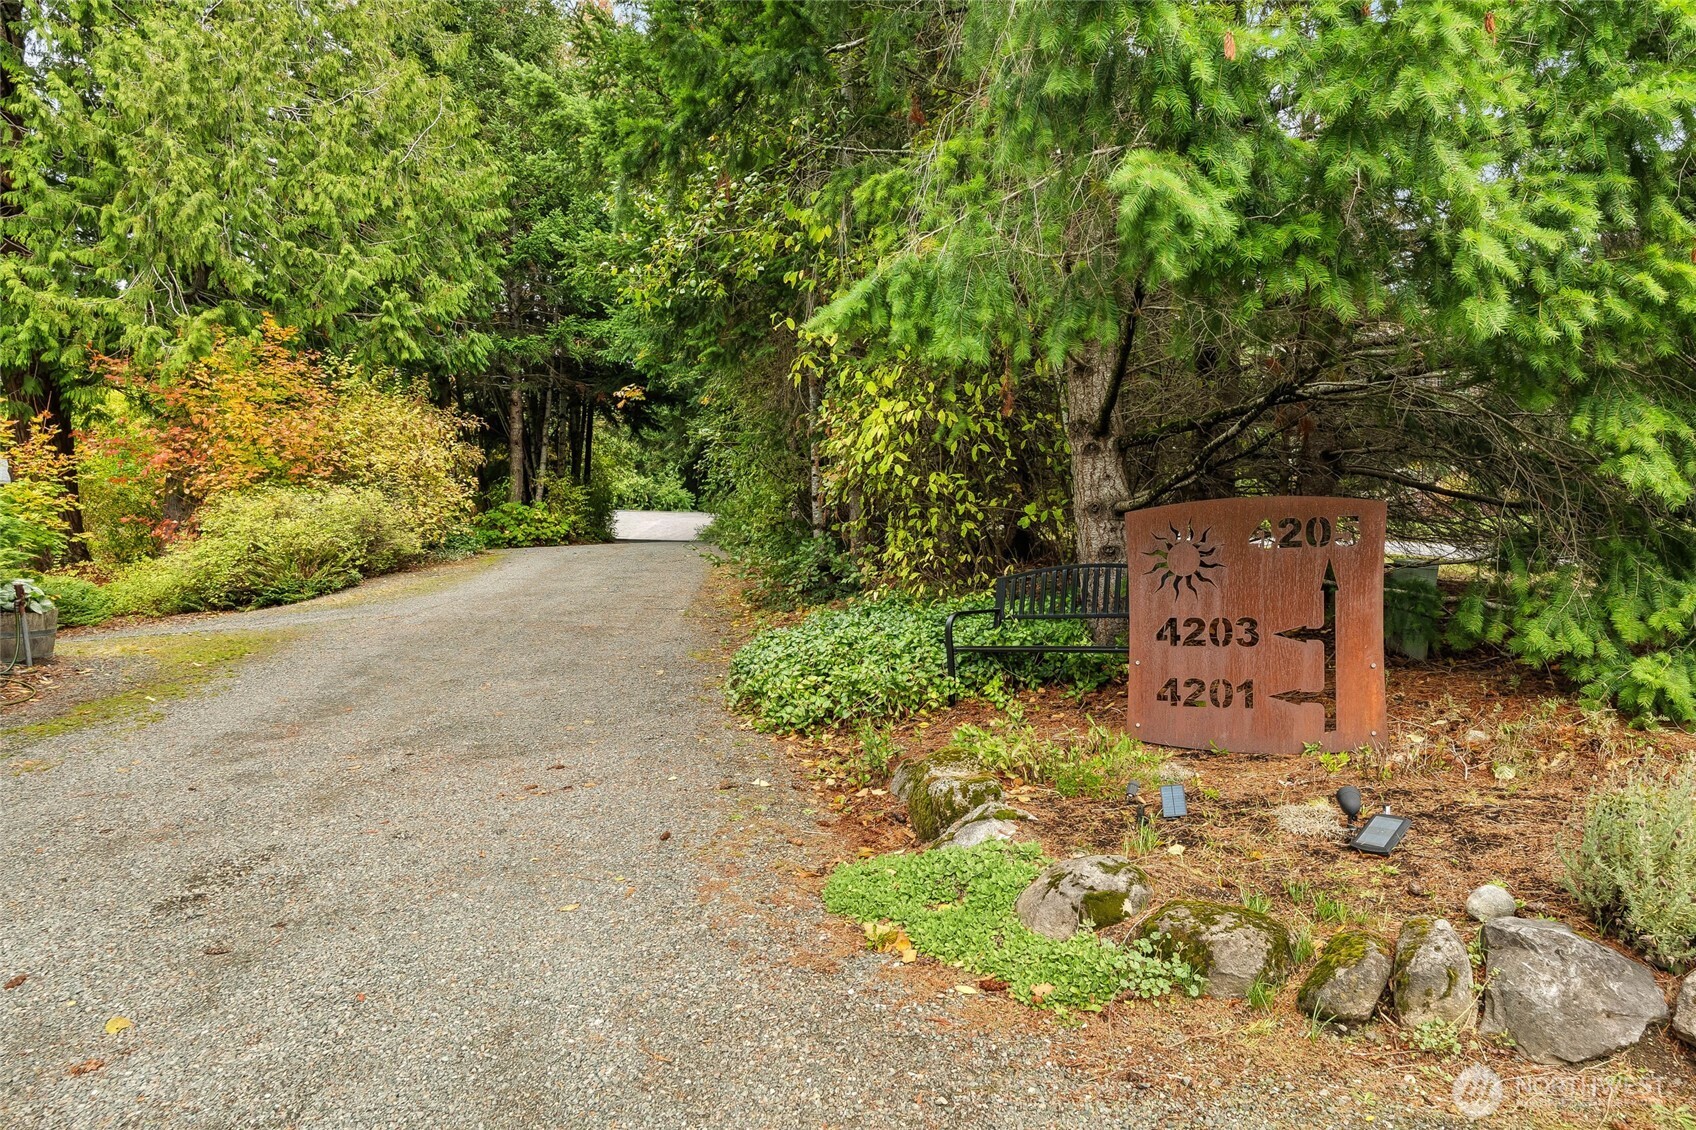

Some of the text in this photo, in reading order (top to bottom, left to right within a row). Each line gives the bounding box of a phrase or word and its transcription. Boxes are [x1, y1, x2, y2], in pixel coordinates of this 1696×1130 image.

[1249, 516, 1360, 548] 4205
[1156, 617, 1260, 647] 4203
[1156, 678, 1254, 709] 4201
